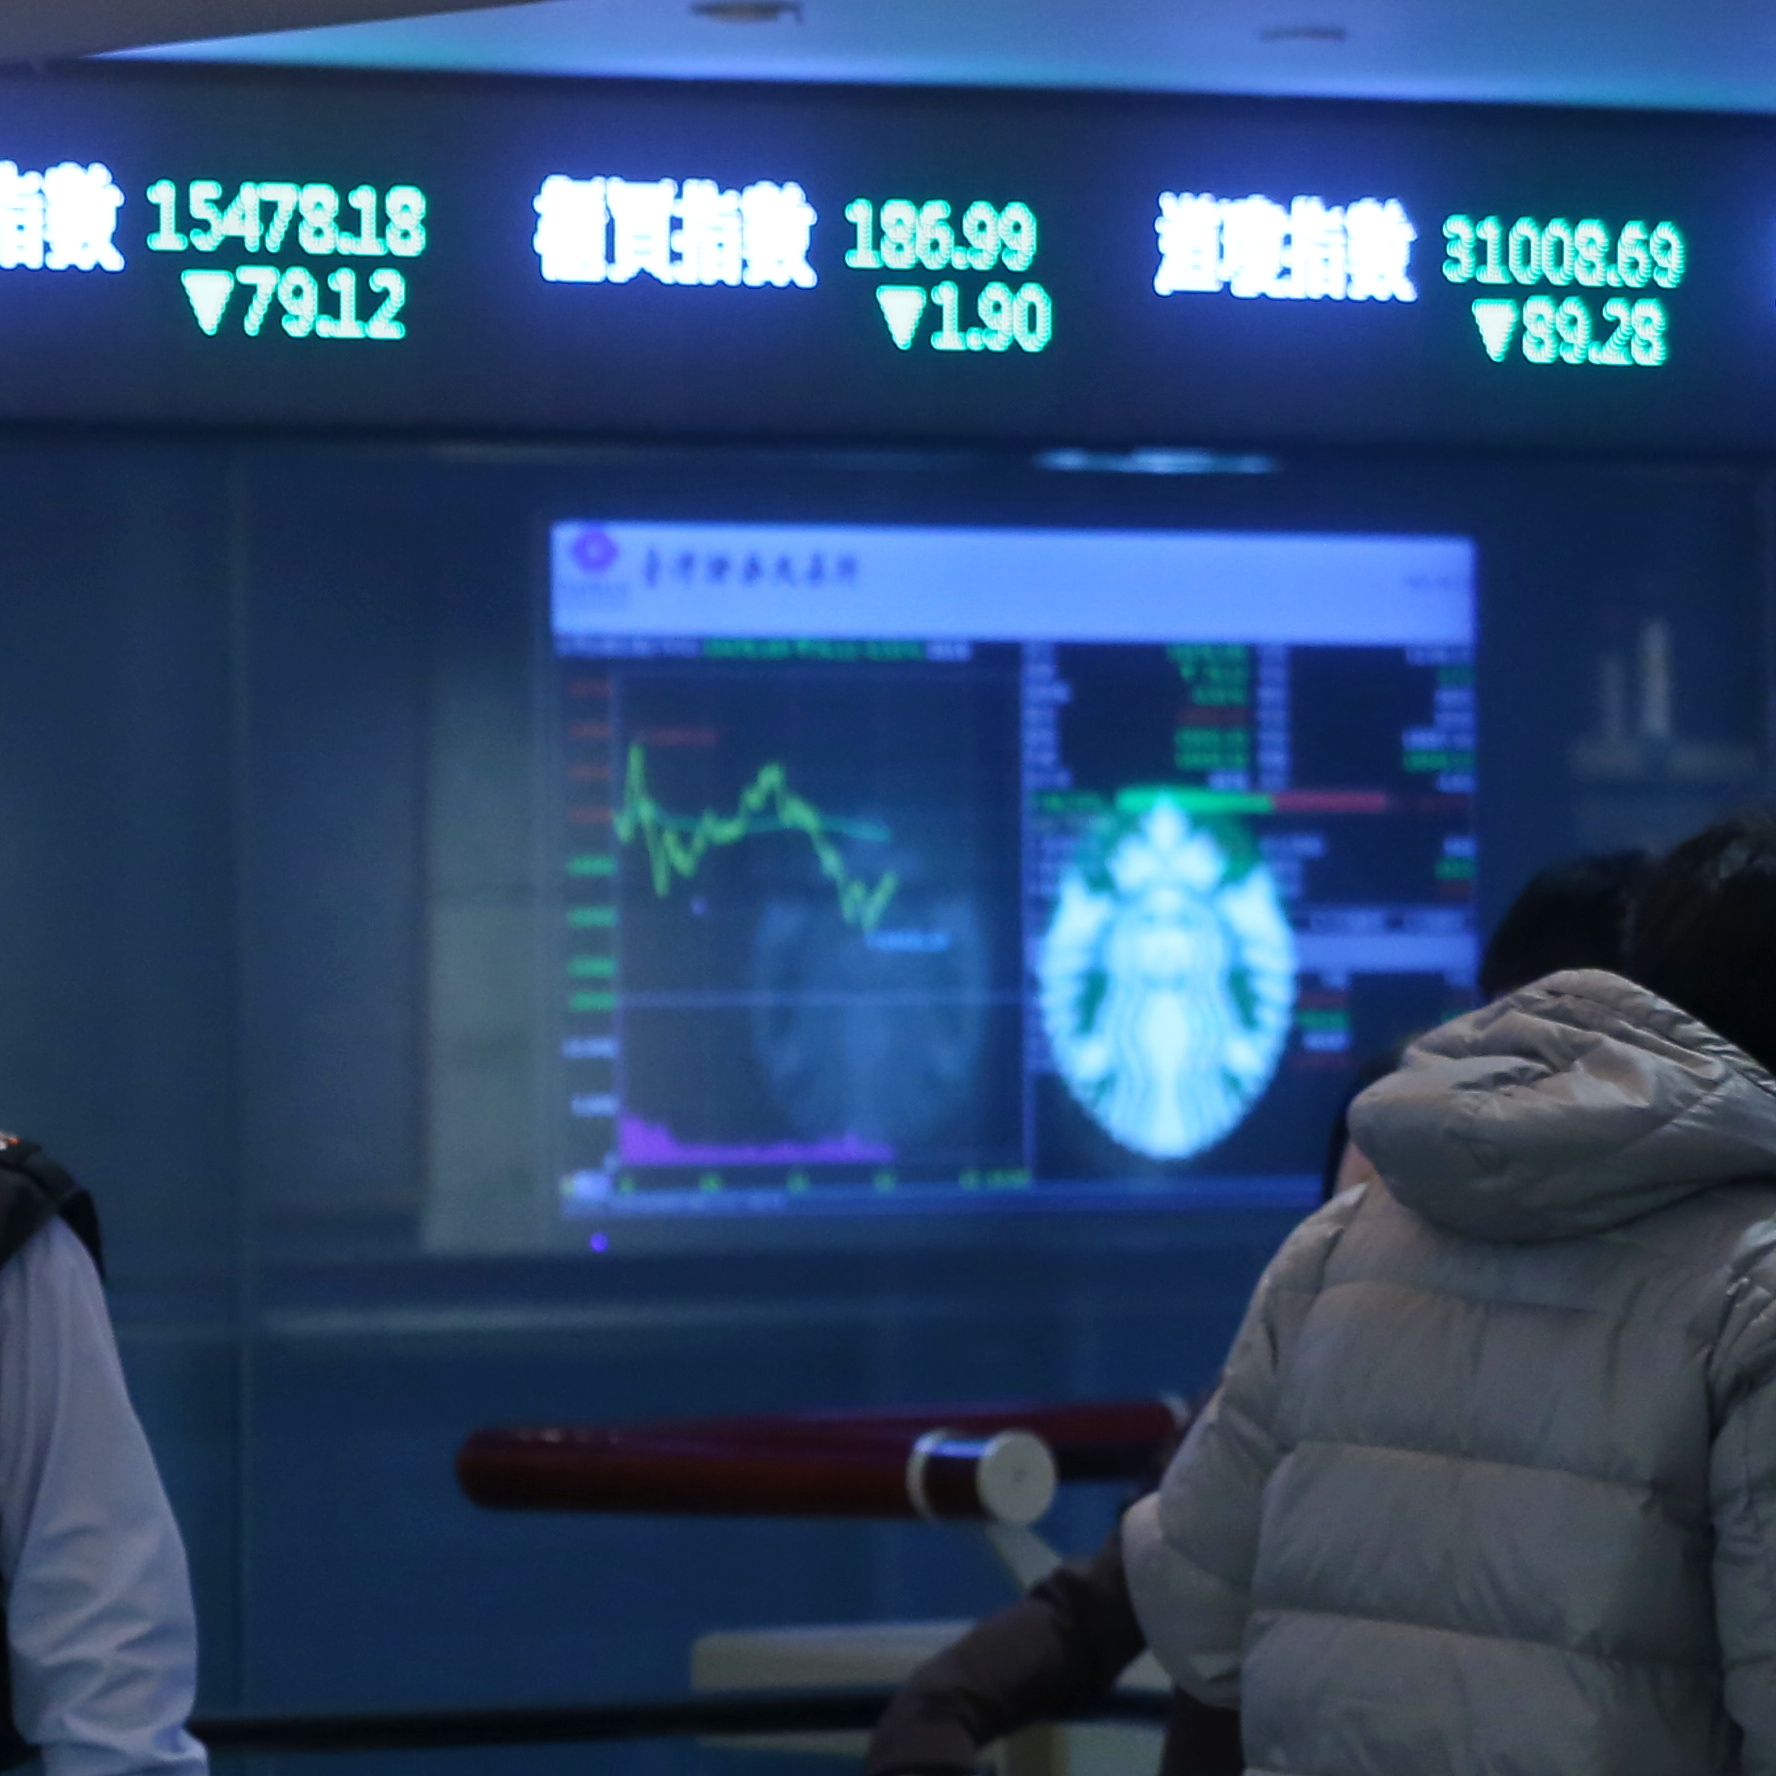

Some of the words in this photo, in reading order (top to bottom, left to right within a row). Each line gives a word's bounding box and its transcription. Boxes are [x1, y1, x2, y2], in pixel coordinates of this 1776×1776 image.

[147, 180, 427, 258] 15478.18
[844, 198, 1038, 272] 186.99
[1443, 215, 1686, 289] 31008.69
[234, 265, 407, 340] 79.12
[930, 281, 1053, 353] 1.90
[1522, 295, 1668, 367] 89.28
